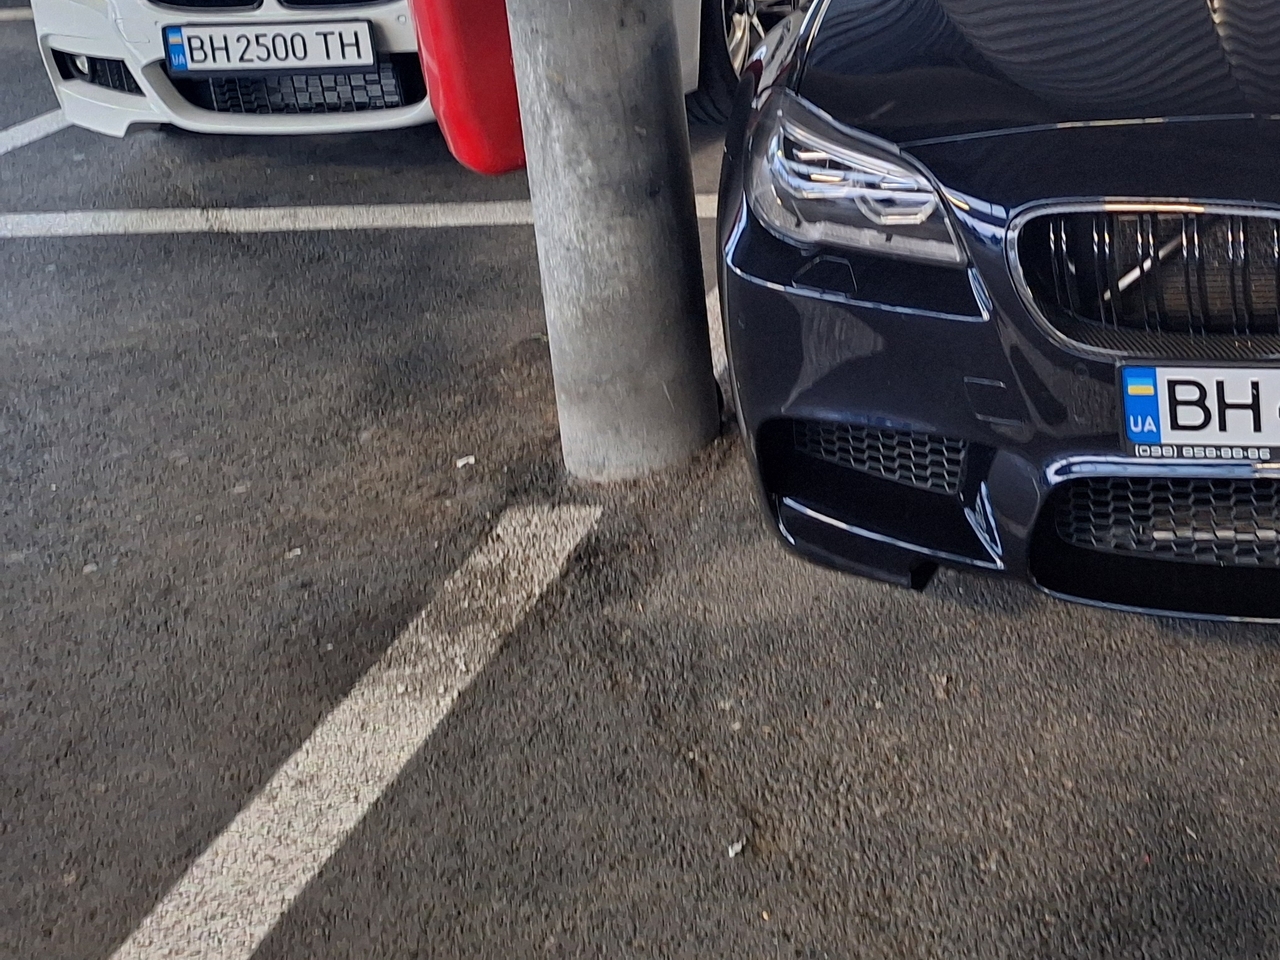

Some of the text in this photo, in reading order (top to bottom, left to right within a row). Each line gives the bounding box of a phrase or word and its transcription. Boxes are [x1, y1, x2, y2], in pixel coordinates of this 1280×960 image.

[171, 54, 186, 66] UA
[187, 30, 362, 64] BH 2500 TH
[1167, 379, 1262, 433] BH
[1129, 415, 1156, 434] UA
